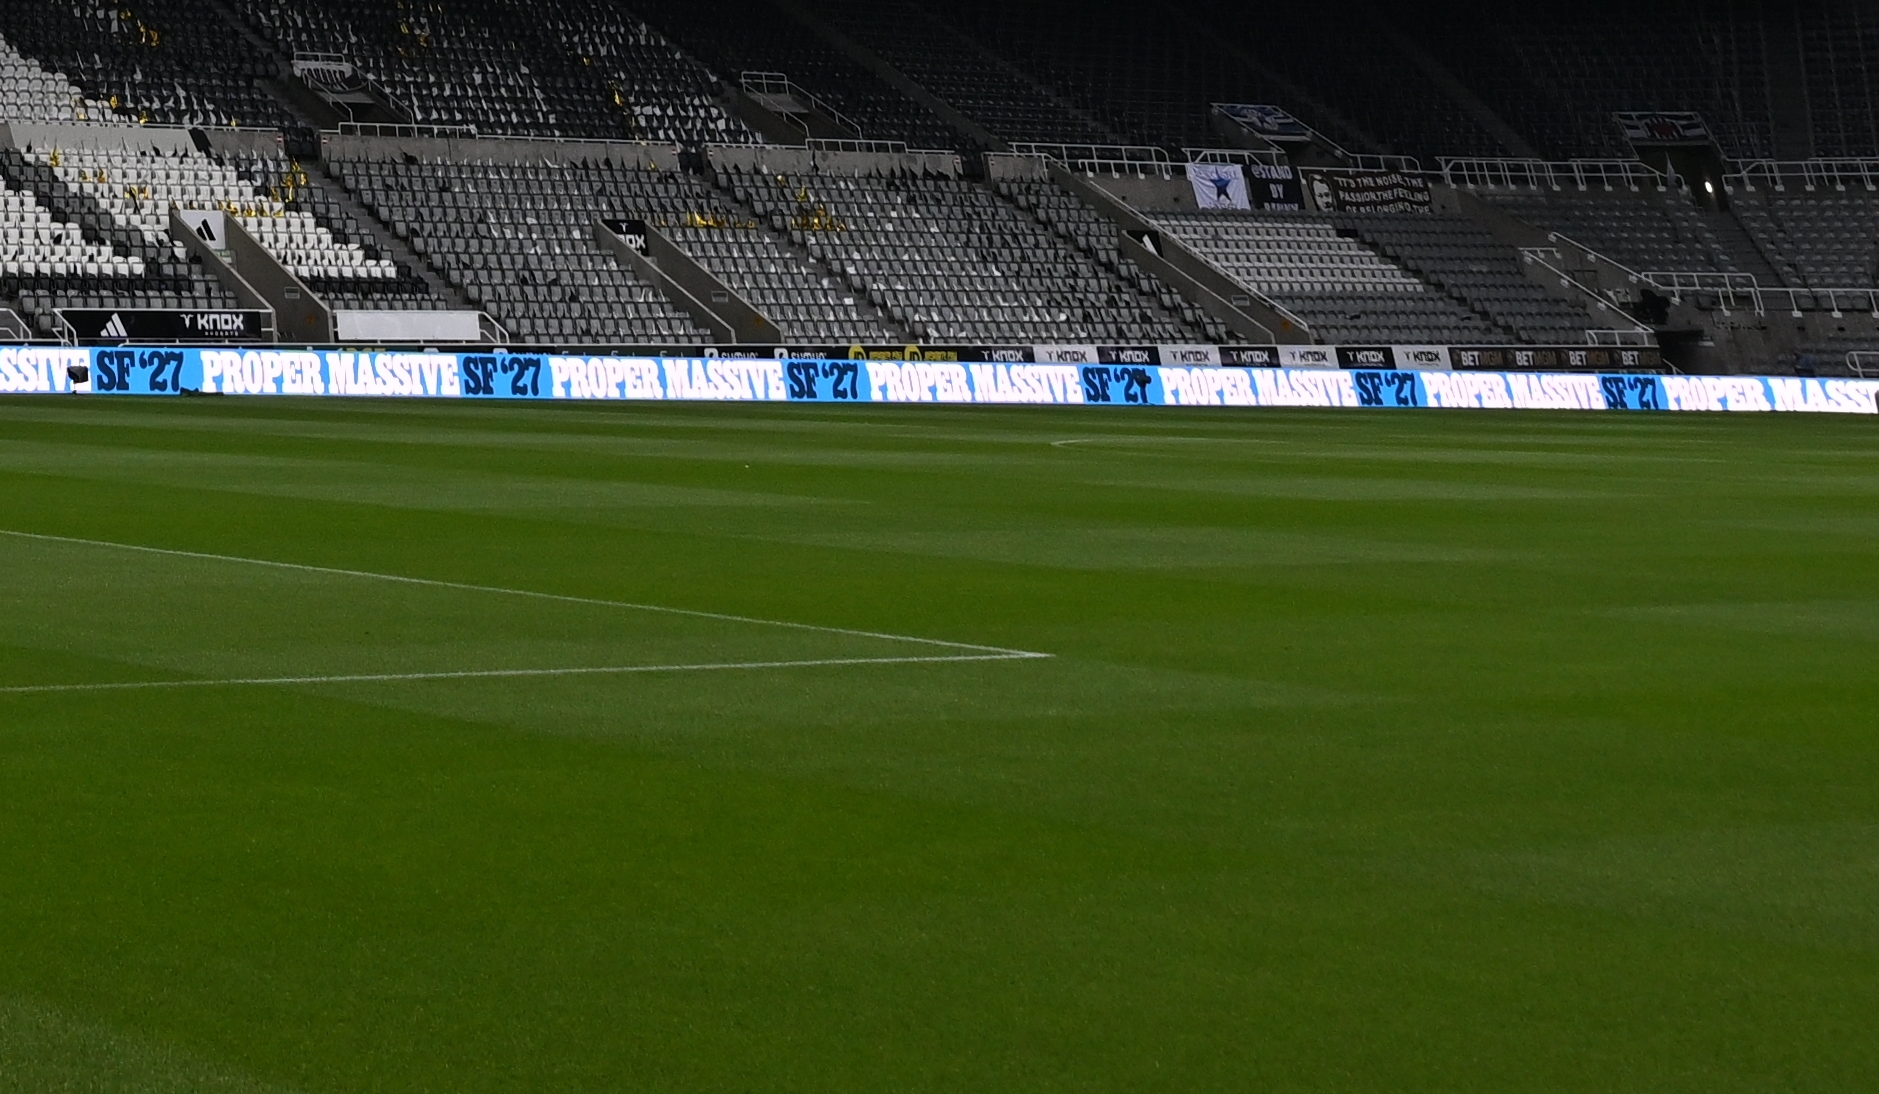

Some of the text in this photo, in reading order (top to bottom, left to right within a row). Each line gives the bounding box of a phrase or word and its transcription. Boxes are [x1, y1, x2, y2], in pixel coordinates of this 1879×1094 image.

[196, 314, 244, 330] KNOX
[97, 351, 136, 391] SF
[202, 351, 324, 394] PROPER
[328, 354, 460, 397] MASSIVE
[463, 357, 497, 395] SF
[992, 350, 1024, 362] KNOX
[1118, 350, 1150, 363] KNOX
[1357, 351, 1388, 364] KNOX
[552, 357, 658, 399] PROPER
[666, 361, 785, 402] MASSIVE
[789, 362, 820, 400] SF
[869, 362, 968, 404] PROPER
[974, 364, 1082, 405] MASSIVE
[1085, 365, 1113, 402] SF
[1161, 367, 1256, 405] PROPER
[1255, 370, 1354, 407] MASSIVE
[1358, 372, 1383, 406] SF
[1420, 372, 1513, 408] PROPER
[1506, 374, 1607, 410] MASSIVE
[1601, 376, 1630, 409] SF
[1665, 377, 1767, 413] PROPER
